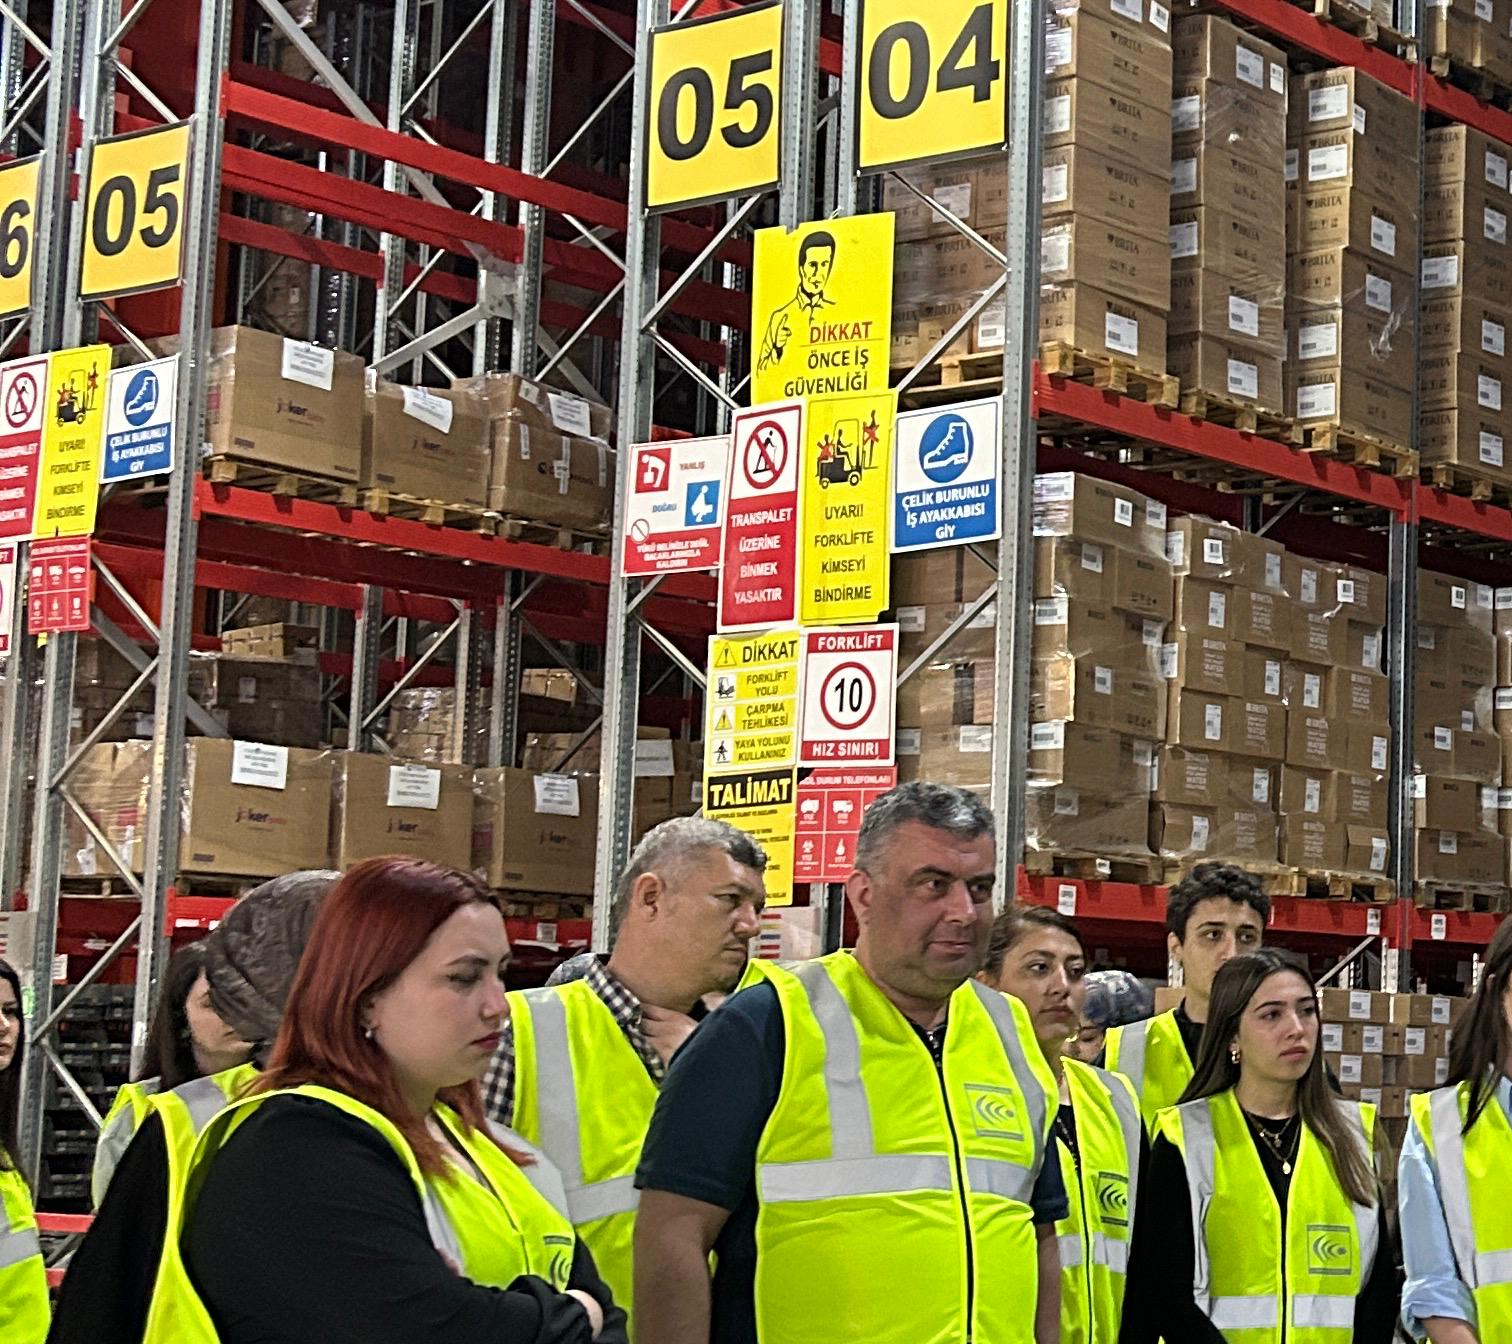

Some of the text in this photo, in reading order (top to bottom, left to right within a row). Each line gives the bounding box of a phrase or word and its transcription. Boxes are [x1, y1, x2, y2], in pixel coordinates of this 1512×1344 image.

[1118, 33, 1143, 49] BRITA
[868, 3, 1000, 119] 04
[1319, 75, 1347, 86] BRITA
[657, 50, 774, 161] 05
[1116, 101, 1142, 120] BRITA
[1318, 135, 1347, 147] BRITA
[1114, 169, 1138, 186] BRITA
[92, 163, 180, 256] 05
[1314, 195, 1342, 207] BRITA
[1115, 237, 1140, 254] BRITA
[1307, 254, 1335, 266] BRITA
[810, 321, 872, 343] DİKKAT
[808, 346, 869, 369] ÖNCE İŞ
[784, 371, 868, 397] GÜVENLİĞİ
[902, 484, 990, 511] ÇELİK BURUNLU
[730, 507, 793, 528] TRANSPALET
[906, 502, 985, 528] İŞ AYAKKABISI
[814, 529, 874, 547] FORKLİFTE
[935, 523, 956, 539] GİY
[739, 534, 780, 552] ÜZERİNE
[740, 562, 778, 578] BİNMEK
[821, 555, 865, 573] KİMSEYİ
[734, 587, 782, 604] YASAKTIR
[814, 584, 872, 603] BİNDİRME
[818, 634, 883, 651] FORKLİFT
[742, 640, 797, 663] DİKKAT
[747, 669, 789, 684] FORKLİFT
[755, 686, 778, 697] YOLU
[834, 677, 863, 712] 10
[746, 703, 785, 716] ÇARPMA
[742, 715, 788, 730] TEHLİKESİ
[735, 735, 791, 749] YAYA YOLUNU
[812, 741, 879, 756] HIZ SINIRI
[738, 748, 786, 761] KULLANINIZ
[710, 776, 791, 807] TALİMAT
